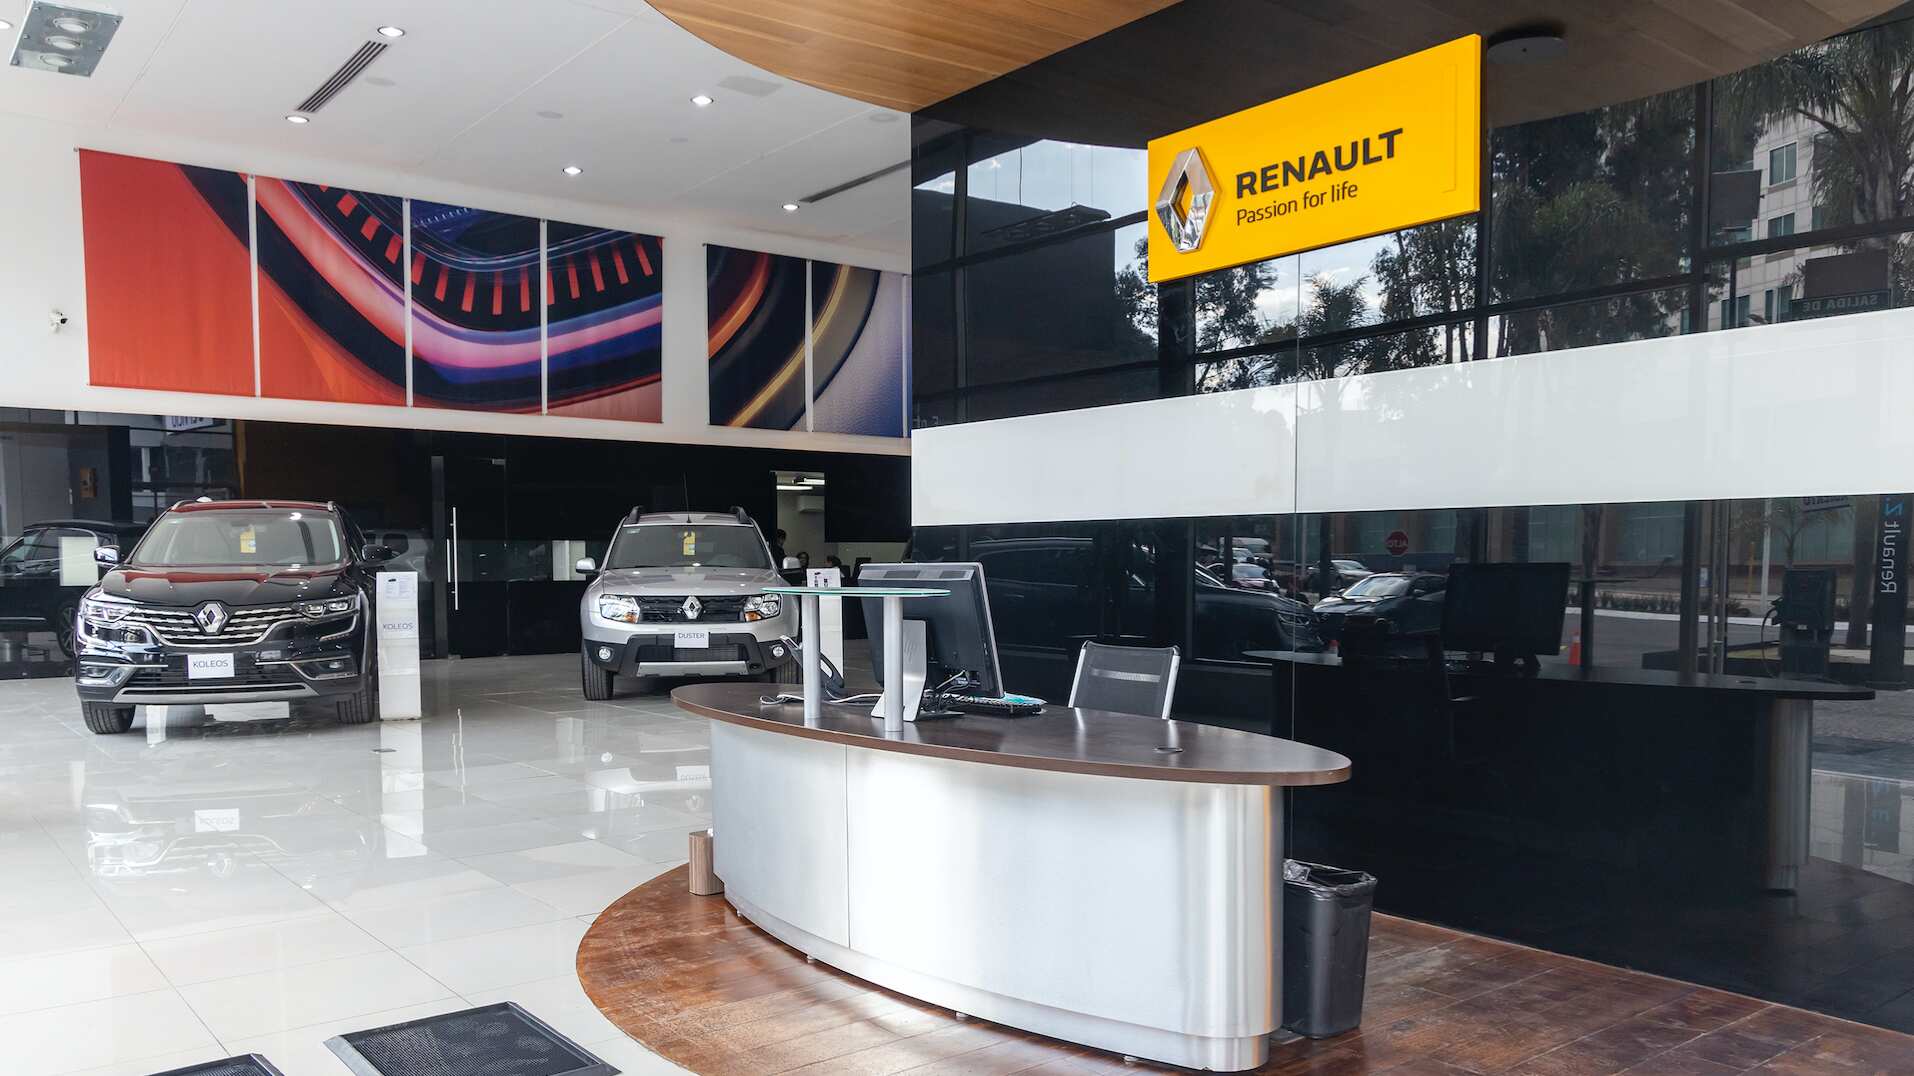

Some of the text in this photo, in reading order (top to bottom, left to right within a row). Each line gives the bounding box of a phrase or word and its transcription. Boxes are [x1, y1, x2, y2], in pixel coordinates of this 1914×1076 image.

[1236, 128, 1403, 199] RENAULT
[1237, 181, 1358, 226] Passion for life
[382, 622, 414, 630] KOLEOS
[193, 659, 229, 668] KOLEOS
